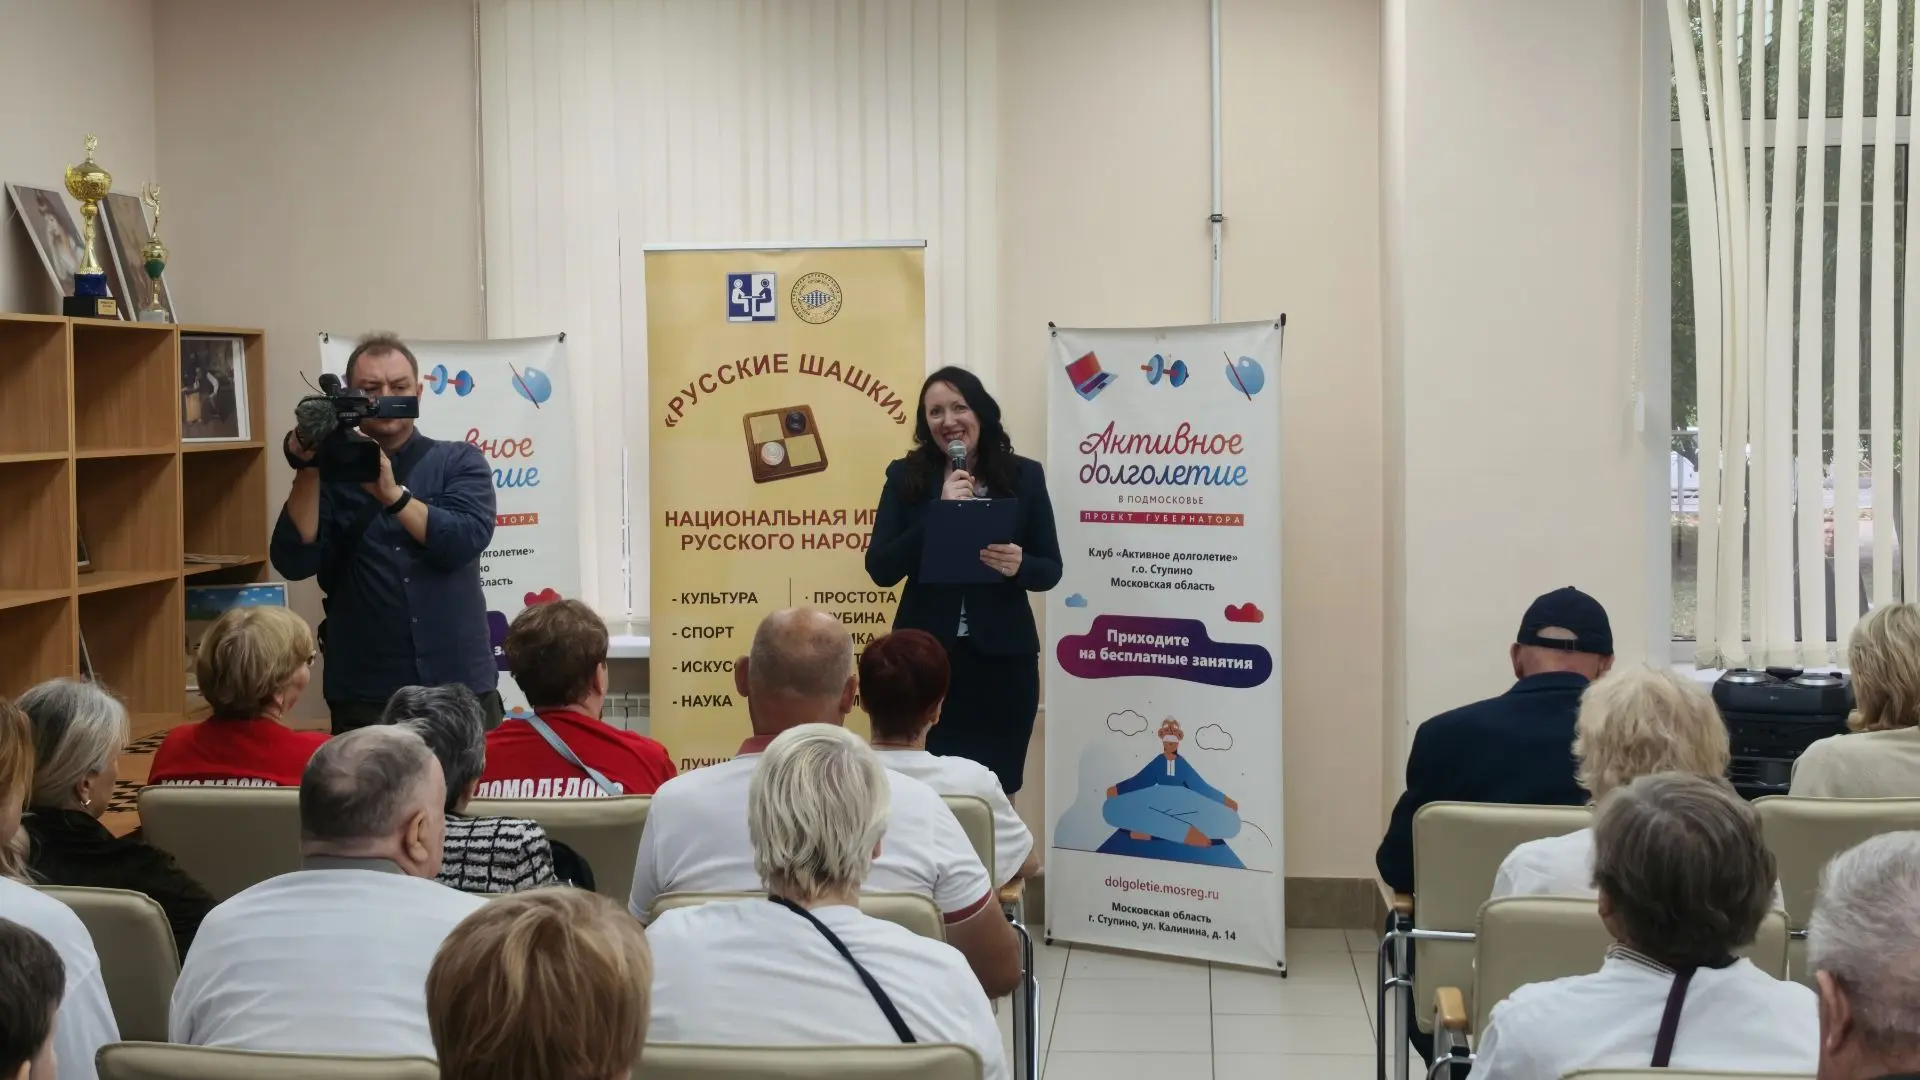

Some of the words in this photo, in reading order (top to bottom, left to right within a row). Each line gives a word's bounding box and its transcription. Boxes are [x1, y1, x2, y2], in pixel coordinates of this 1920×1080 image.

[664, 353, 789, 427] «РУССКИЕ
[799, 353, 907, 424] ШАШКИ»
[1079, 420, 1243, 455] Активное
[1079, 451, 1248, 486] долголетие
[1118, 494, 1124, 504] В
[1127, 495, 1204, 504] ПОДМОСКОВЬЕ
[665, 510, 847, 529] НАЦИОНАЛЬНАЯ
[854, 509, 878, 525] ИГ
[1085, 512, 1134, 521] ПРОЕКТ
[1146, 513, 1240, 524] ГУБЕРНАТОРА
[681, 533, 795, 551] РУССКОГО
[802, 533, 872, 552] НАРОД
[1088, 548, 1113, 560] Клуб
[1116, 549, 1170, 561] «Активное
[1173, 552, 1238, 563] долголетие»
[1131, 565, 1147, 575] г.о.
[1150, 564, 1193, 577] Ступино
[1111, 578, 1171, 590] Московская
[1174, 581, 1215, 592] область
[681, 592, 758, 605] КУЛЬТУРА
[814, 591, 897, 604] ПРОСТОТА
[829, 612, 886, 624] УБИНА
[681, 627, 734, 640] СПОРТ
[1107, 629, 1189, 647] Приходите
[1079, 649, 1097, 660] на
[1099, 648, 1187, 665] бесплатные
[1192, 657, 1252, 670] занятия
[681, 694, 733, 707] НАУКА
[1104, 875, 1219, 900] dolgoletie.mosreg.ru
[1111, 902, 1170, 918] Московская
[1173, 910, 1211, 923] область
[1097, 913, 1139, 930] Ступино,
[1142, 922, 1155, 931] ул.
[1158, 922, 1209, 938] Калинина,
[1212, 932, 1221, 940] д.
[1225, 930, 1236, 940] 14
